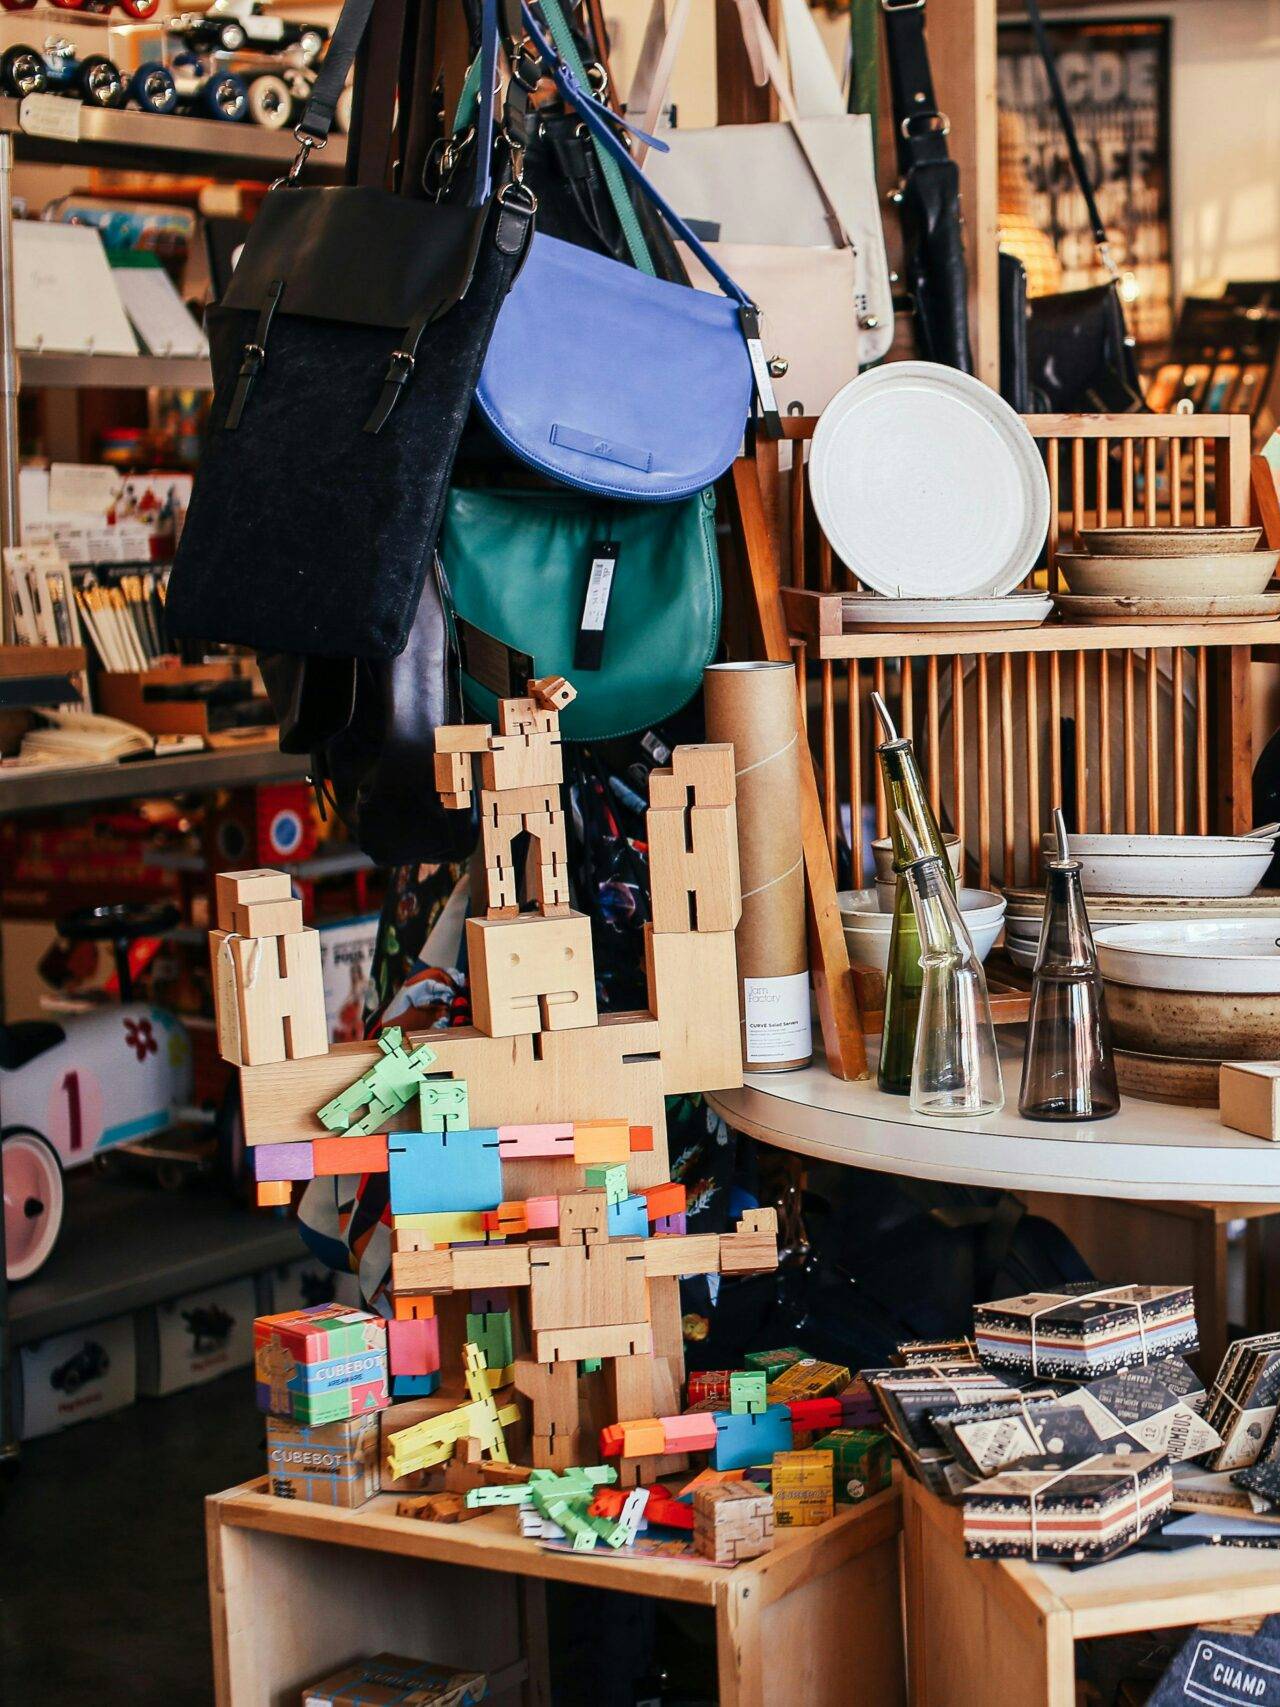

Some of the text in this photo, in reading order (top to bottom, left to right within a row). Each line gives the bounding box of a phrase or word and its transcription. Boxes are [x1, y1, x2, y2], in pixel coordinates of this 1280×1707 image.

[748, 994, 781, 1003] Factory
[750, 986, 768, 995] Jam
[62, 1071, 82, 1151] 1
[316, 1355, 383, 1380] CUBEBOT
[1167, 1413, 1193, 1460] RHOMBUS
[271, 1450, 344, 1466] CUBEBOT
[1213, 1663, 1266, 1696] CHAMP
